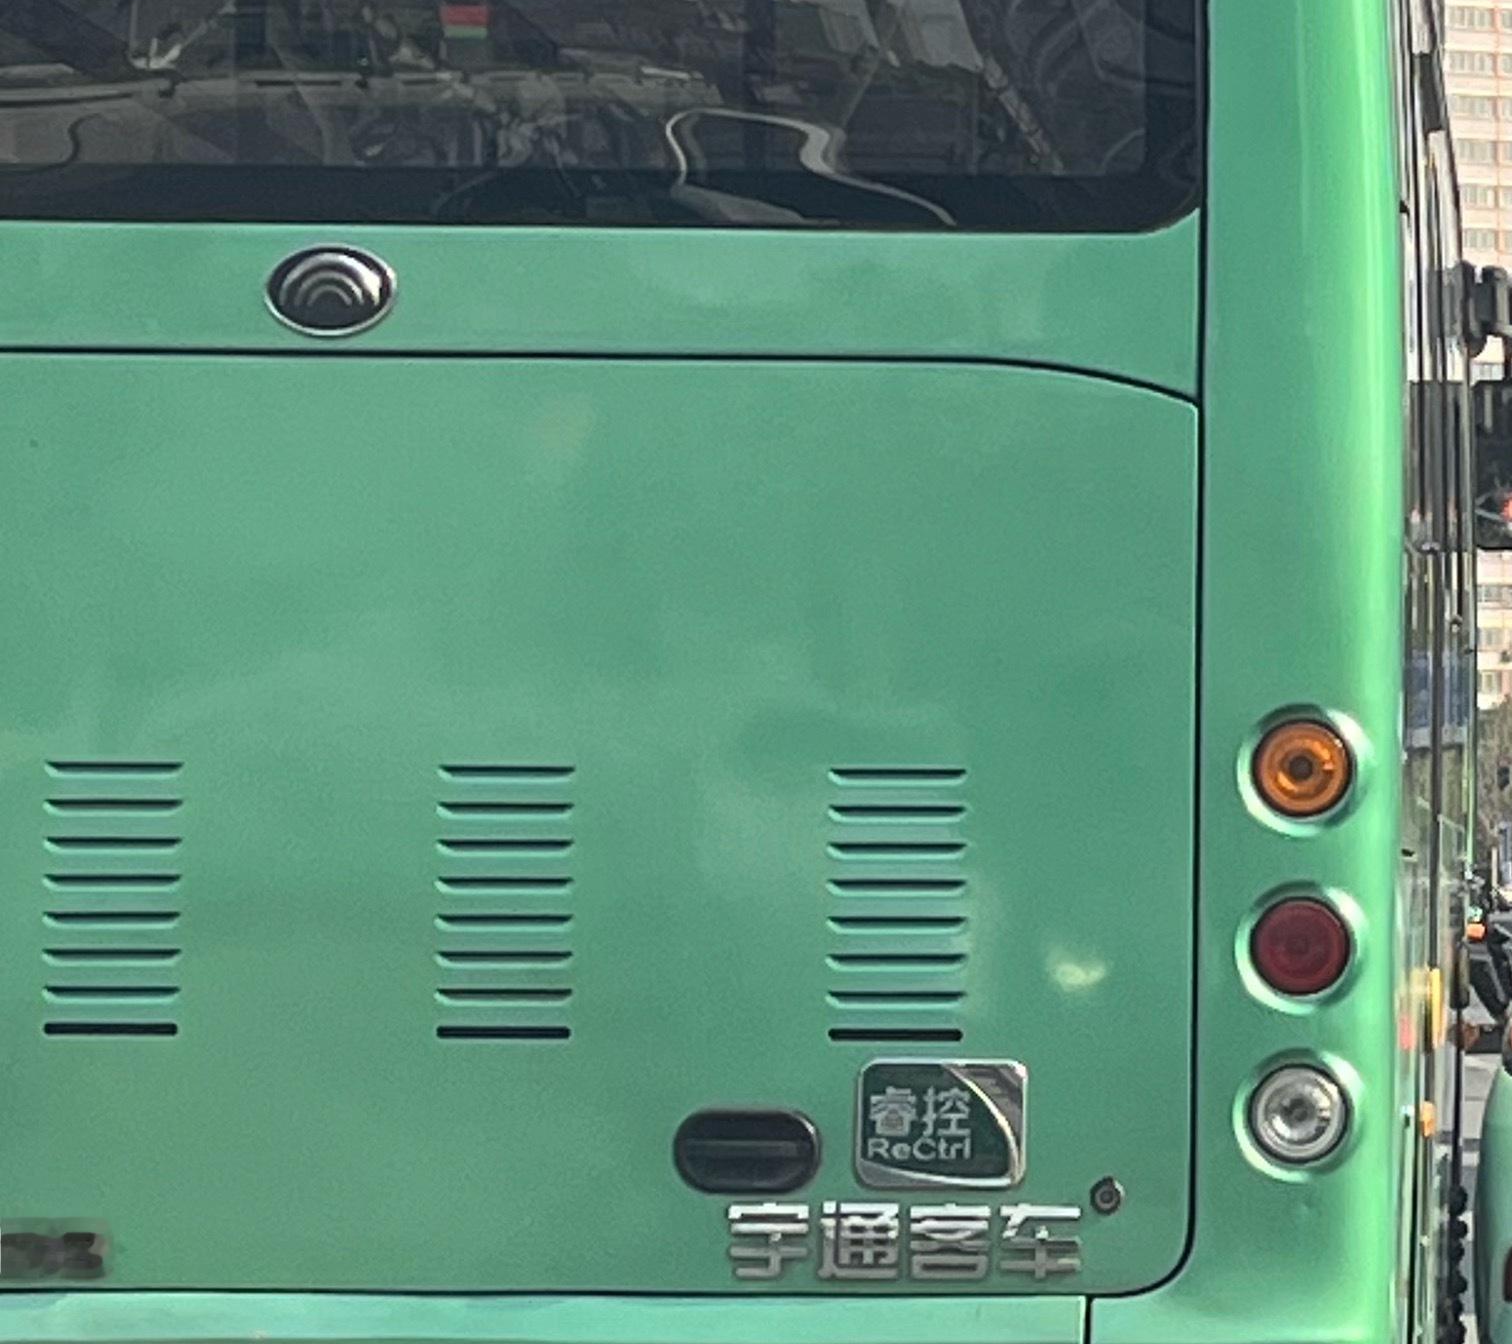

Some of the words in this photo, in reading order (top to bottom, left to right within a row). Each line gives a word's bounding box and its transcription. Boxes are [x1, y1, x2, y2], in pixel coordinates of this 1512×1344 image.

[869, 1086, 972, 1138] 睿控
[867, 1137, 972, 1161] ReCtrl
[728, 1201, 1082, 1281] 宇通客车
